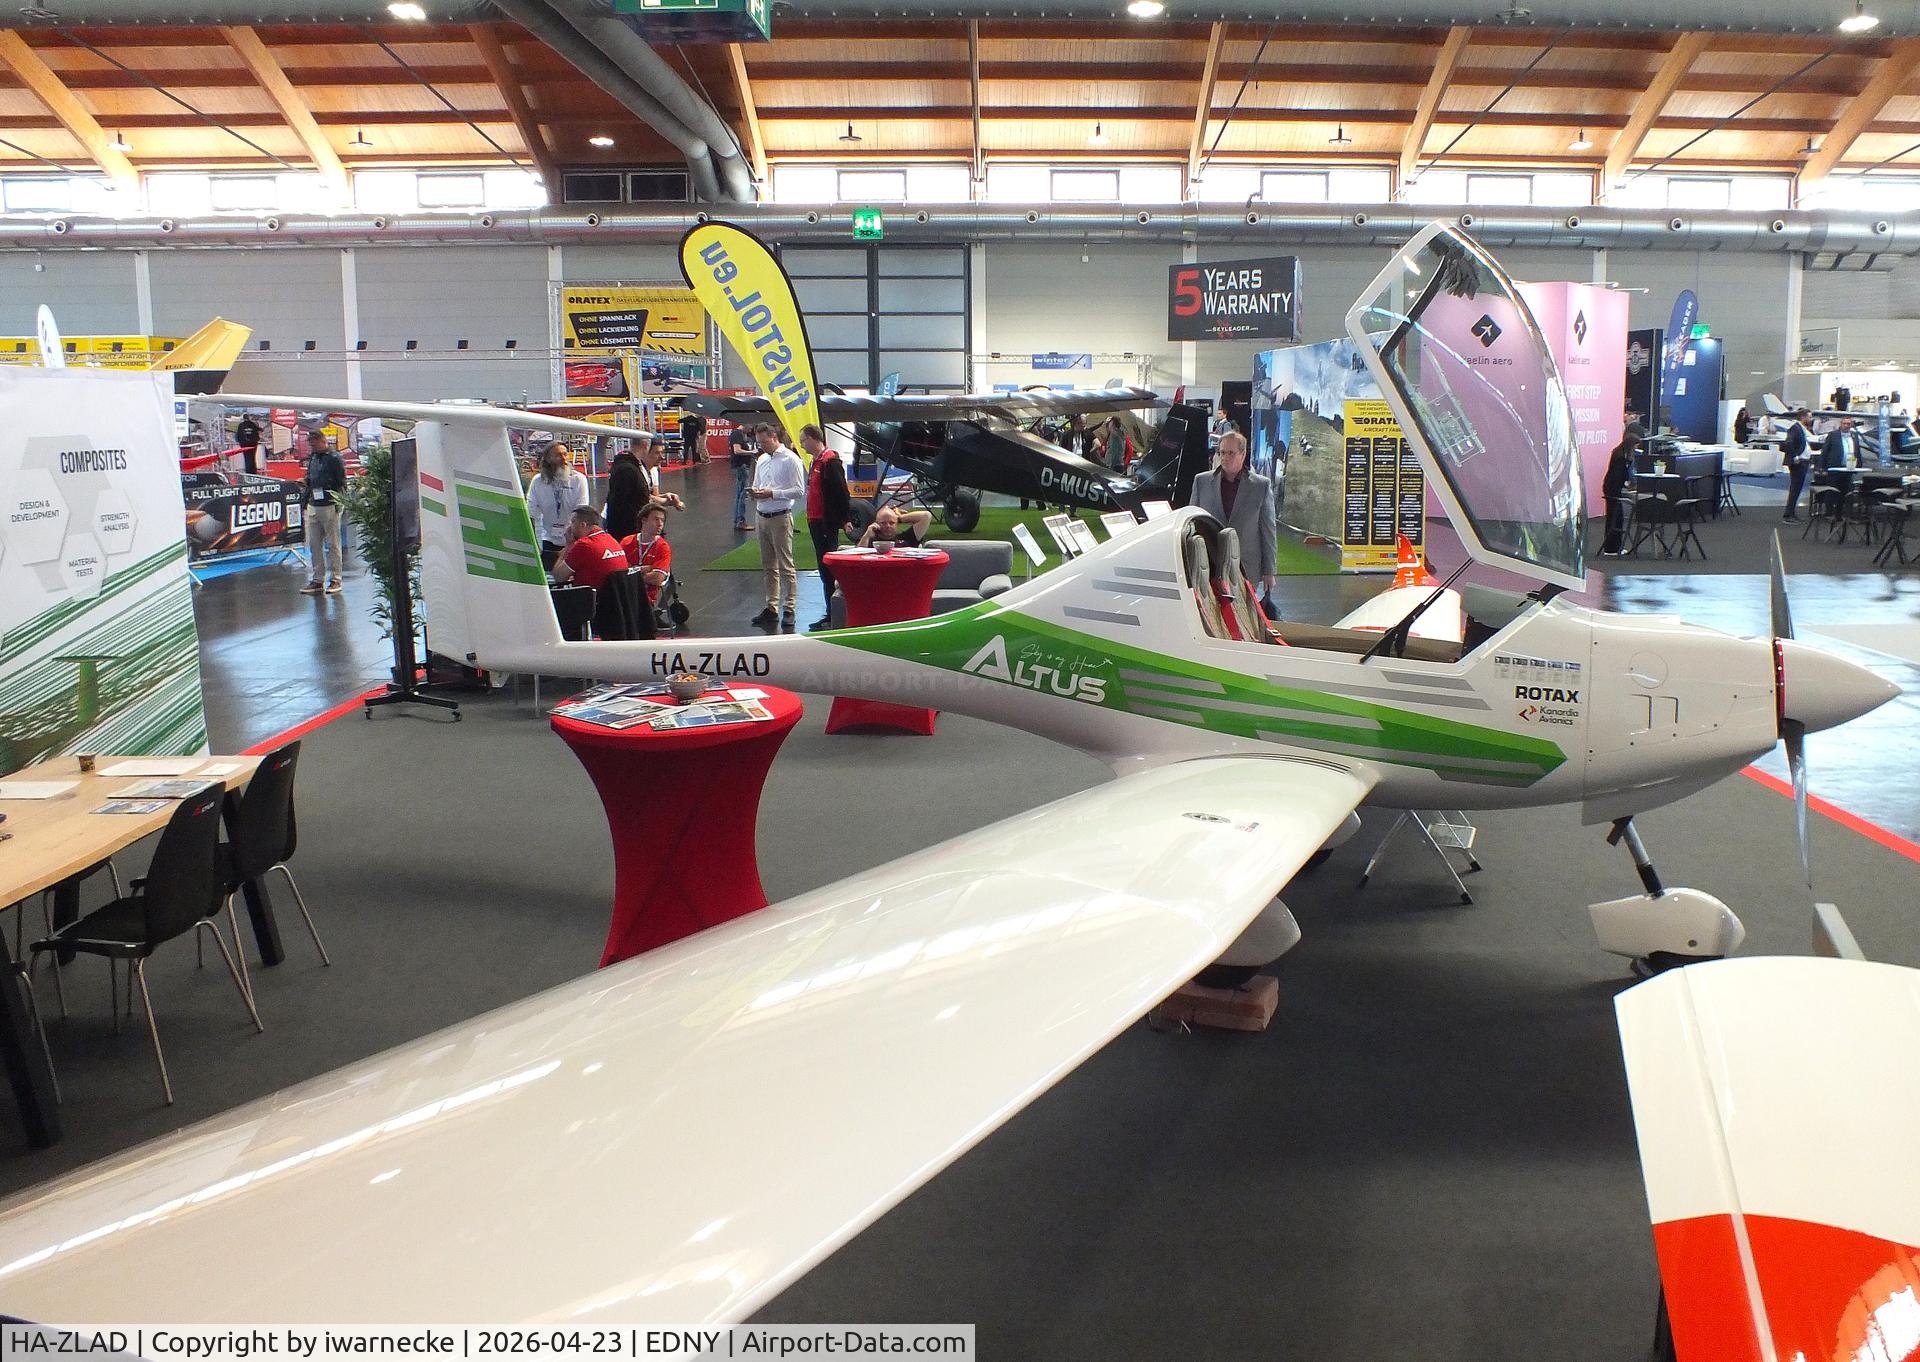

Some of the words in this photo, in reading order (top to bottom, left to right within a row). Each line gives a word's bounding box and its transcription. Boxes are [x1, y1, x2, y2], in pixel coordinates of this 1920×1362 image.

[1204, 268, 1262, 291] YEARS
[1175, 269, 1203, 317] 5
[568, 296, 611, 304] ORATEX
[1203, 291, 1292, 315] WARRANTY
[599, 314, 637, 322] SPANNLACK
[598, 325, 639, 333] LACKIERUNG
[600, 336, 639, 345] LÖSEMITTEL
[1492, 357, 1513, 366] aero
[1585, 384, 1602, 400] STEP
[706, 418, 716, 426] HE
[60, 449, 128, 474] COMPOSITES
[192, 490, 212, 500] FULL
[214, 487, 239, 497] FLIGHT
[241, 484, 281, 495] SIMULATOR
[19, 500, 45, 510] DESIGN
[45, 499, 50, 508] &
[11, 509, 60, 523] DEVELOPMENT
[100, 512, 130, 522] STRENGTH
[230, 501, 282, 535] LEGEND
[103, 522, 130, 532] ANALYSIS
[68, 556, 98, 568] MATERIAL
[75, 567, 94, 578] TESTS
[651, 652, 770, 677] HA-ZLAD
[961, 634, 1108, 703] ALTUS
[1515, 685, 1580, 704] ROTAX
[1539, 706, 1579, 717] Kanardia
[1539, 715, 1574, 725] Avionics
